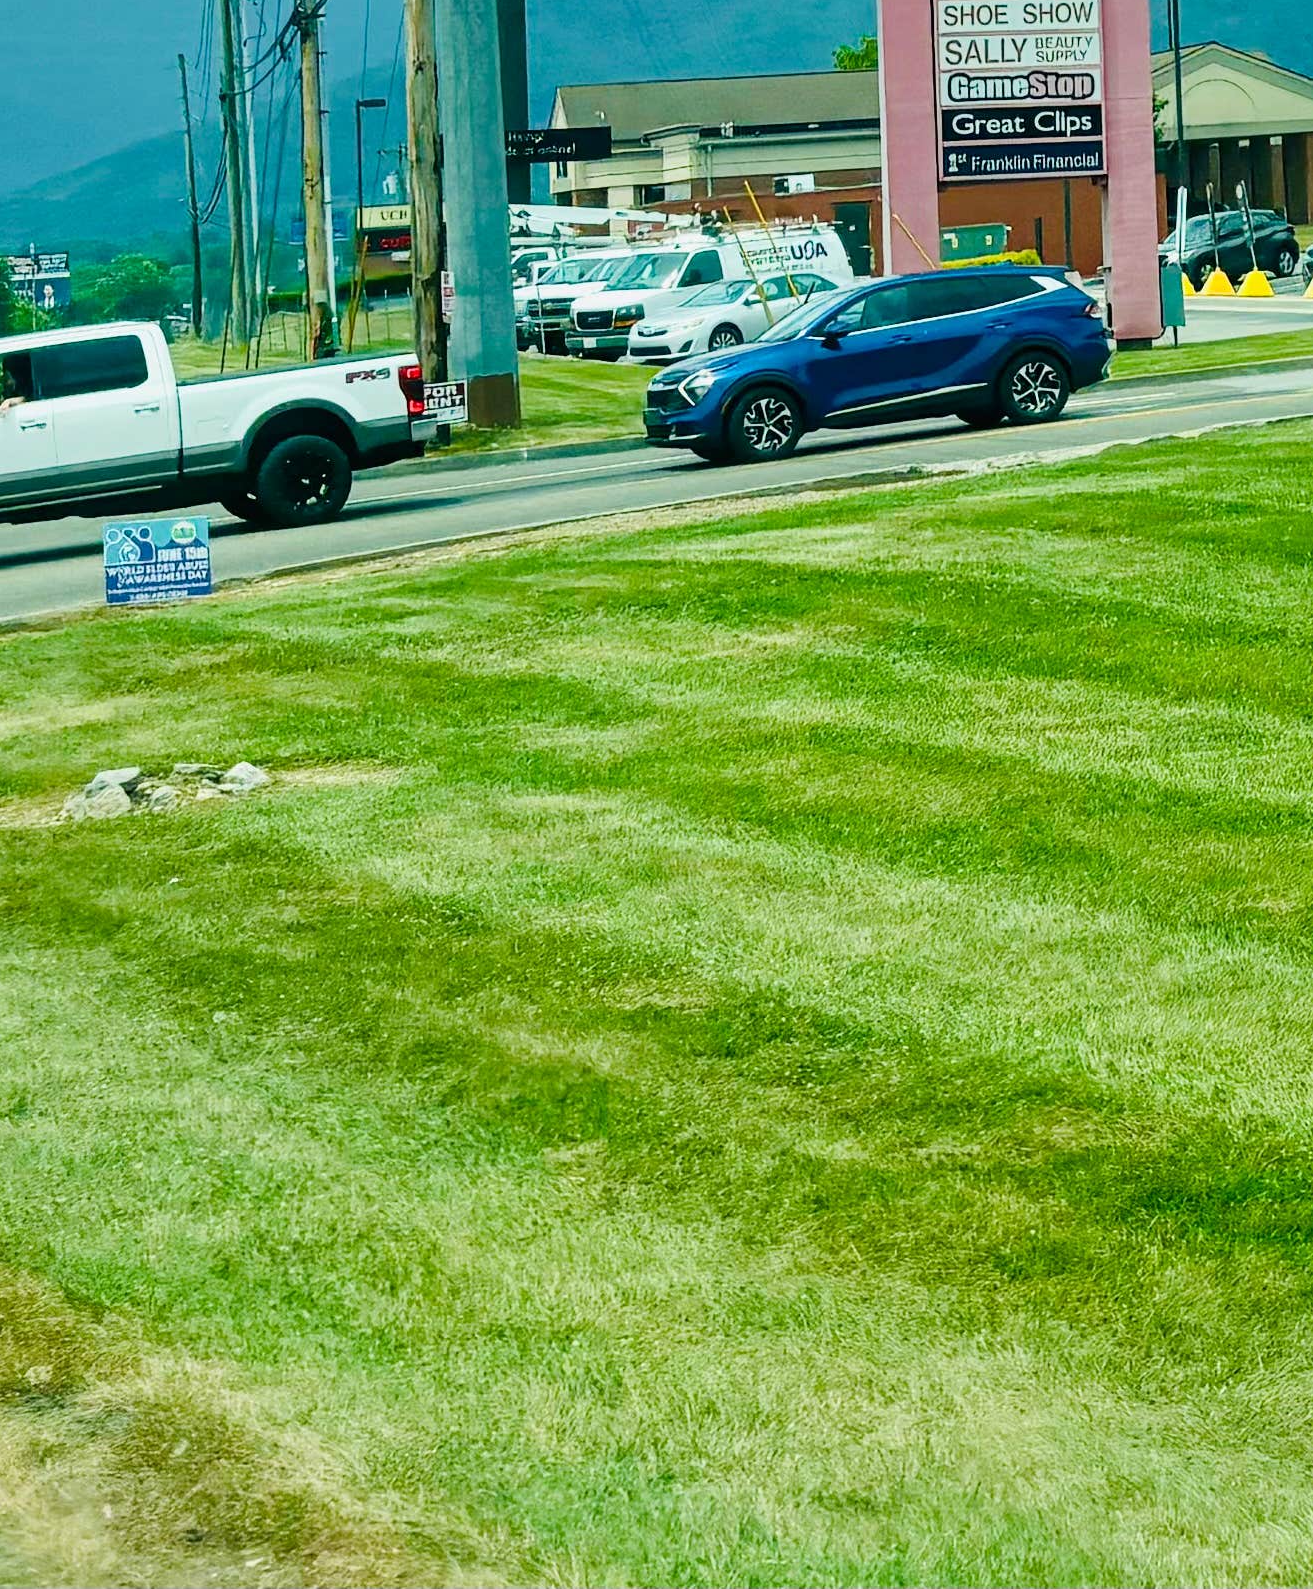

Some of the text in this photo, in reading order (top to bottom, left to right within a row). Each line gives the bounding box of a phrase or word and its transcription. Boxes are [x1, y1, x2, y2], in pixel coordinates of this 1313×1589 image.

[943, 1, 1094, 27] SHOE SHOW
[945, 35, 1094, 66] SALLY BEAUTY
[1035, 50, 1088, 63] SUPPLY
[949, 72, 1094, 101] GameStop
[951, 110, 1093, 137] Great Clips
[948, 152, 1099, 173] 1st Franklin Financial
[177, 559, 209, 572] ABUSE
[187, 570, 208, 580] DAY
